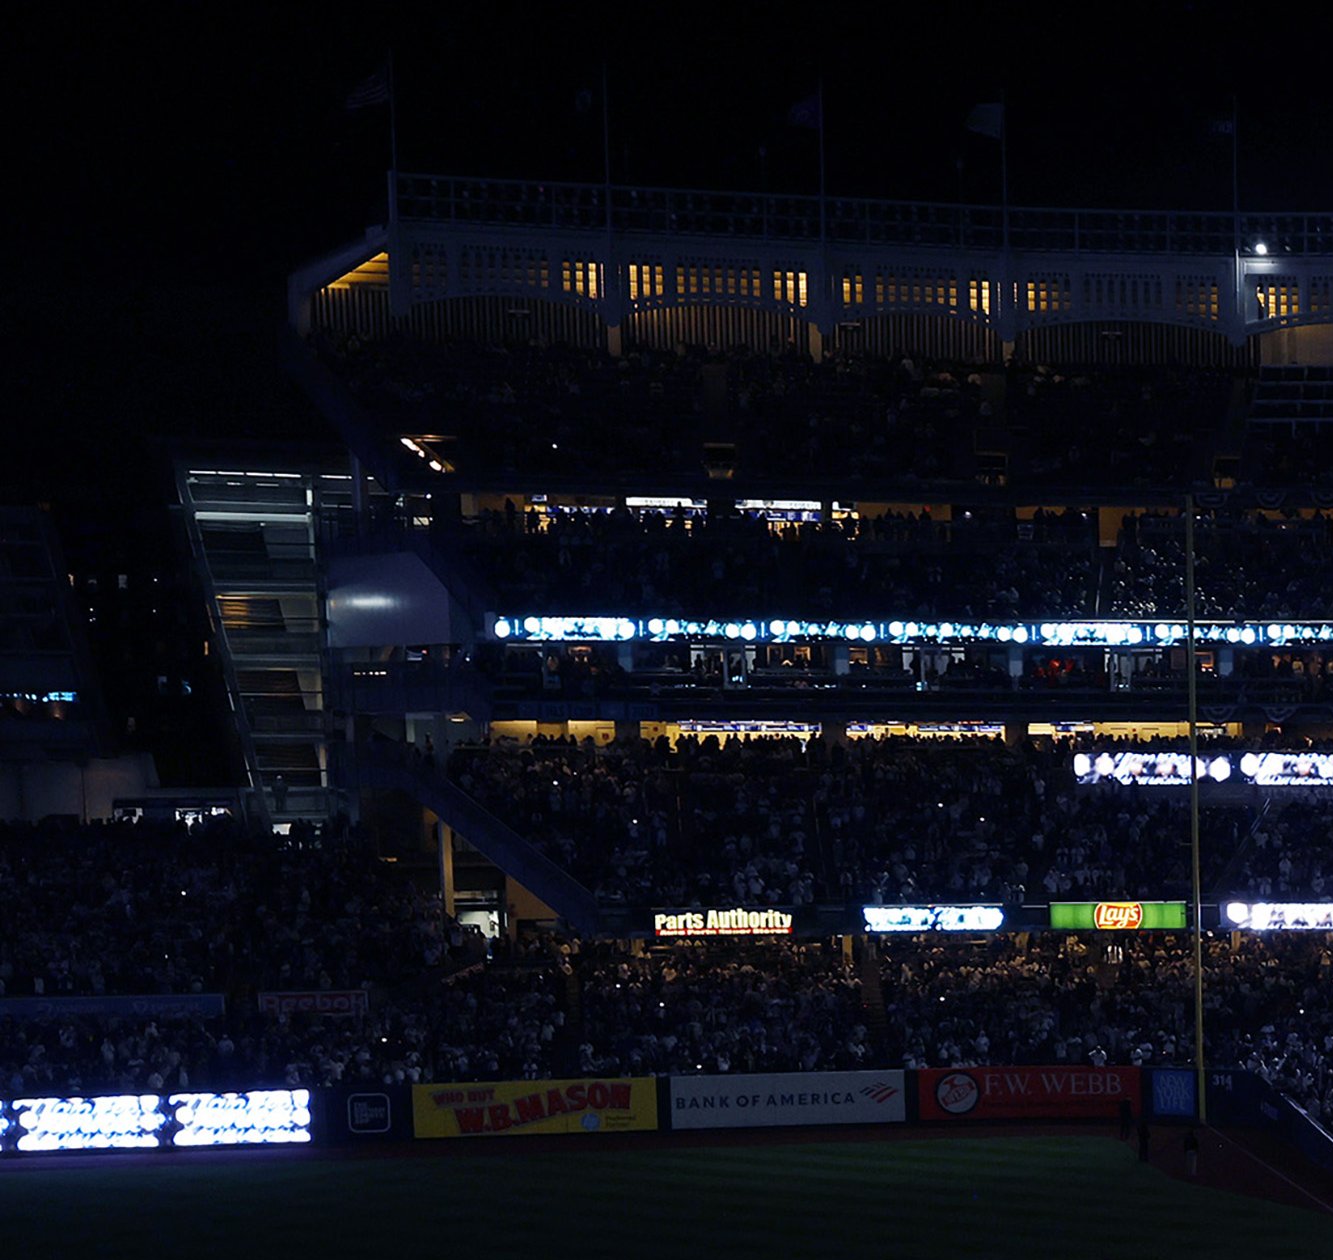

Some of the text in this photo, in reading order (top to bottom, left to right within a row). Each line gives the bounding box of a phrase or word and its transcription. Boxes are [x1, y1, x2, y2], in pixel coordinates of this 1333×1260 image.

[654, 907, 792, 931] Parts Authority
[1098, 903, 1140, 926] Lay's
[467, 1088, 495, 1103] BUT
[983, 1072, 1122, 1096] F.W. WEBB
[514, 1082, 632, 1125] MASON
[675, 1091, 855, 1110] BANK OF AMERICA
